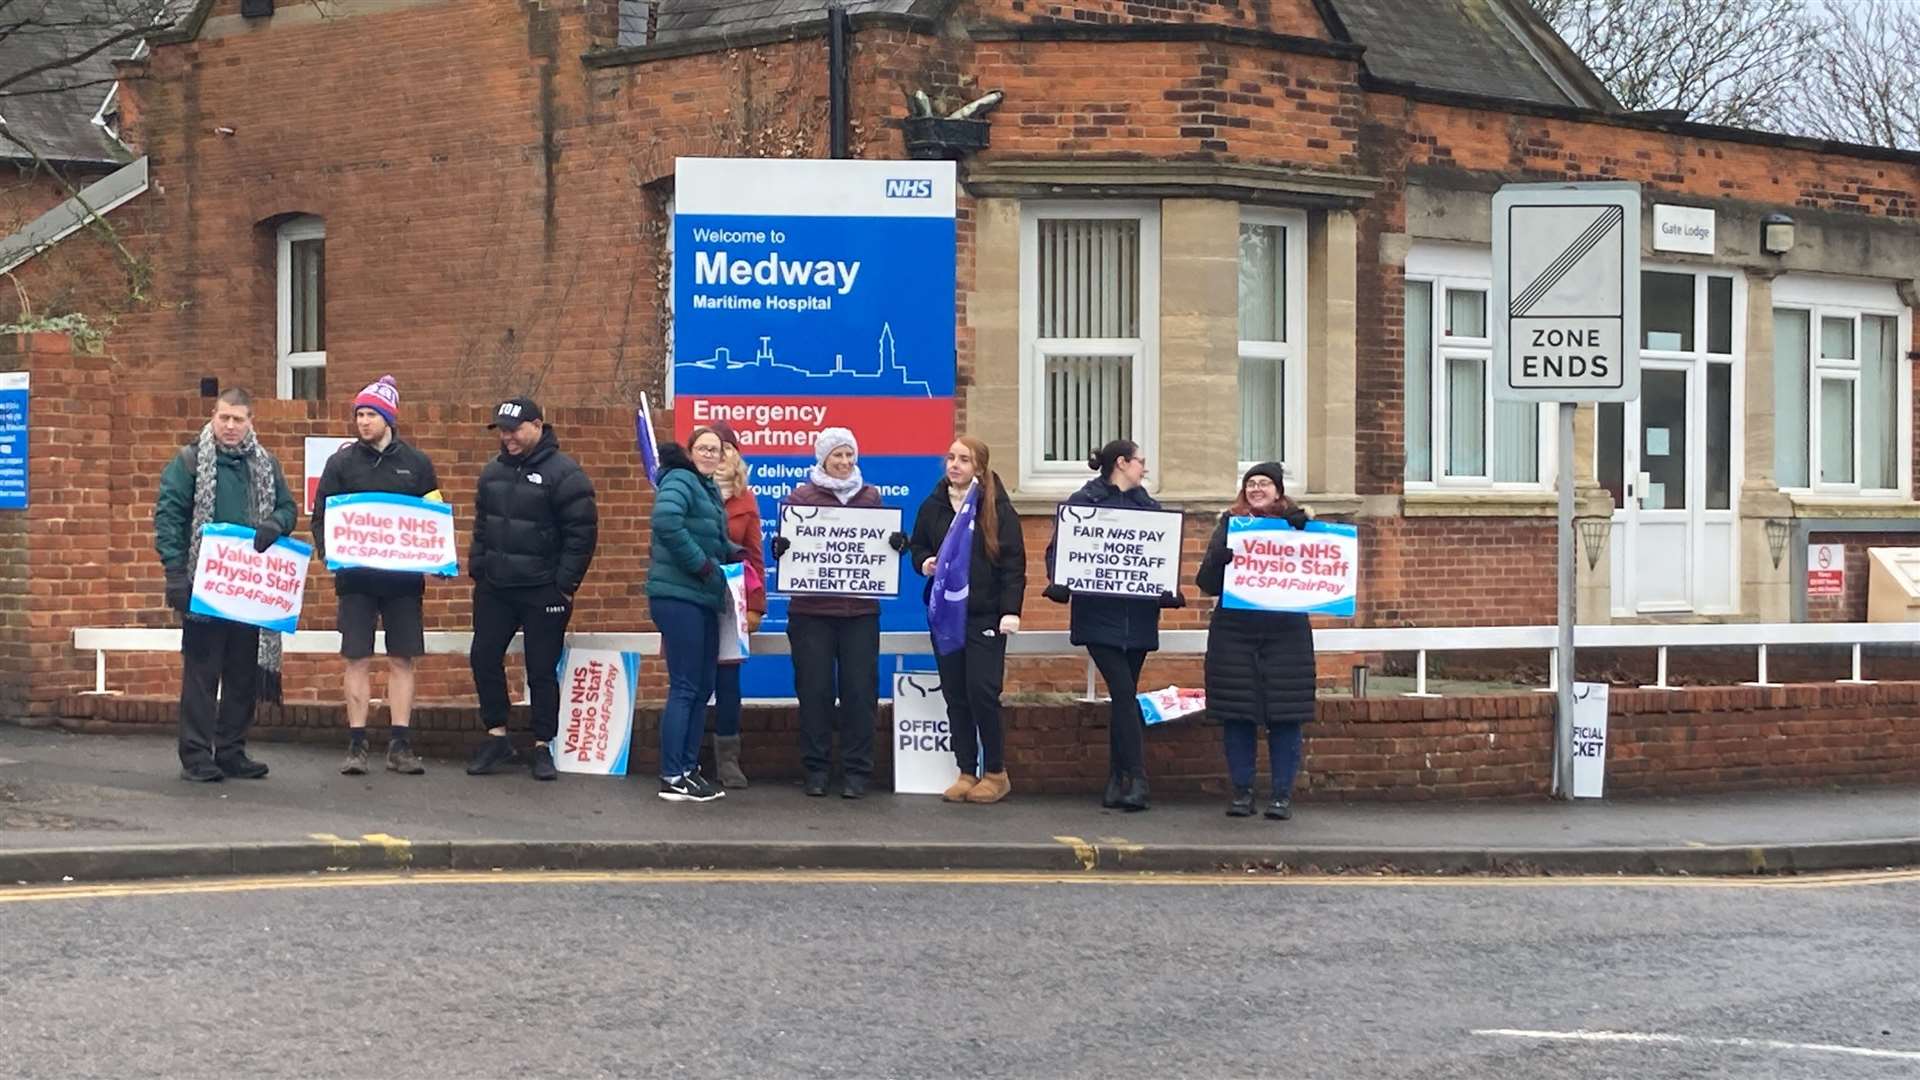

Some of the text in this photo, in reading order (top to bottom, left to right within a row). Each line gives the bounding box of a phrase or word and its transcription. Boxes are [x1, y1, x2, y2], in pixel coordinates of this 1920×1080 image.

[888, 180, 930, 197] NHS
[693, 228, 786, 244] Welcome to
[1662, 222, 1711, 240] Gate Lodge
[695, 251, 861, 294] Medway
[693, 294, 832, 312] Maritime Hospital
[1532, 329, 1600, 347] ZONE
[1523, 354, 1608, 378] ENDS
[693, 400, 827, 425] Emergency
[757, 464, 812, 478] deliver
[342, 512, 438, 534] Value NHS
[333, 526, 446, 549] Physio Staff
[796, 526, 885, 540] FAIR NHS PAY
[1073, 526, 1165, 542] FAIR NHS PAY
[336, 545, 445, 563] #CSP4FairPay
[826, 541, 865, 553] MORE
[1104, 542, 1144, 555] MORE
[1243, 539, 1342, 560] Value NHS
[217, 544, 297, 577] Value NHS
[792, 552, 887, 565] PHYSIO STAFF
[1069, 551, 1166, 568] PHYSIO STAFF
[1234, 555, 1349, 577] Physio Staff
[205, 559, 301, 594] Physio Staff
[818, 567, 870, 580] BETTER
[1095, 568, 1149, 581] BETTER
[791, 578, 886, 591] PATIENT CARE
[1067, 577, 1165, 594] PATIENT CARE
[1234, 575, 1345, 595] #CSP4FairPay
[204, 580, 294, 613] #CSP4FairPay
[565, 667, 587, 753] Value NHS
[578, 660, 603, 761] Physio Staff
[595, 664, 619, 761] #CSP4FairPay
[899, 720, 949, 733] OFFIC
[900, 735, 950, 752] PICK
